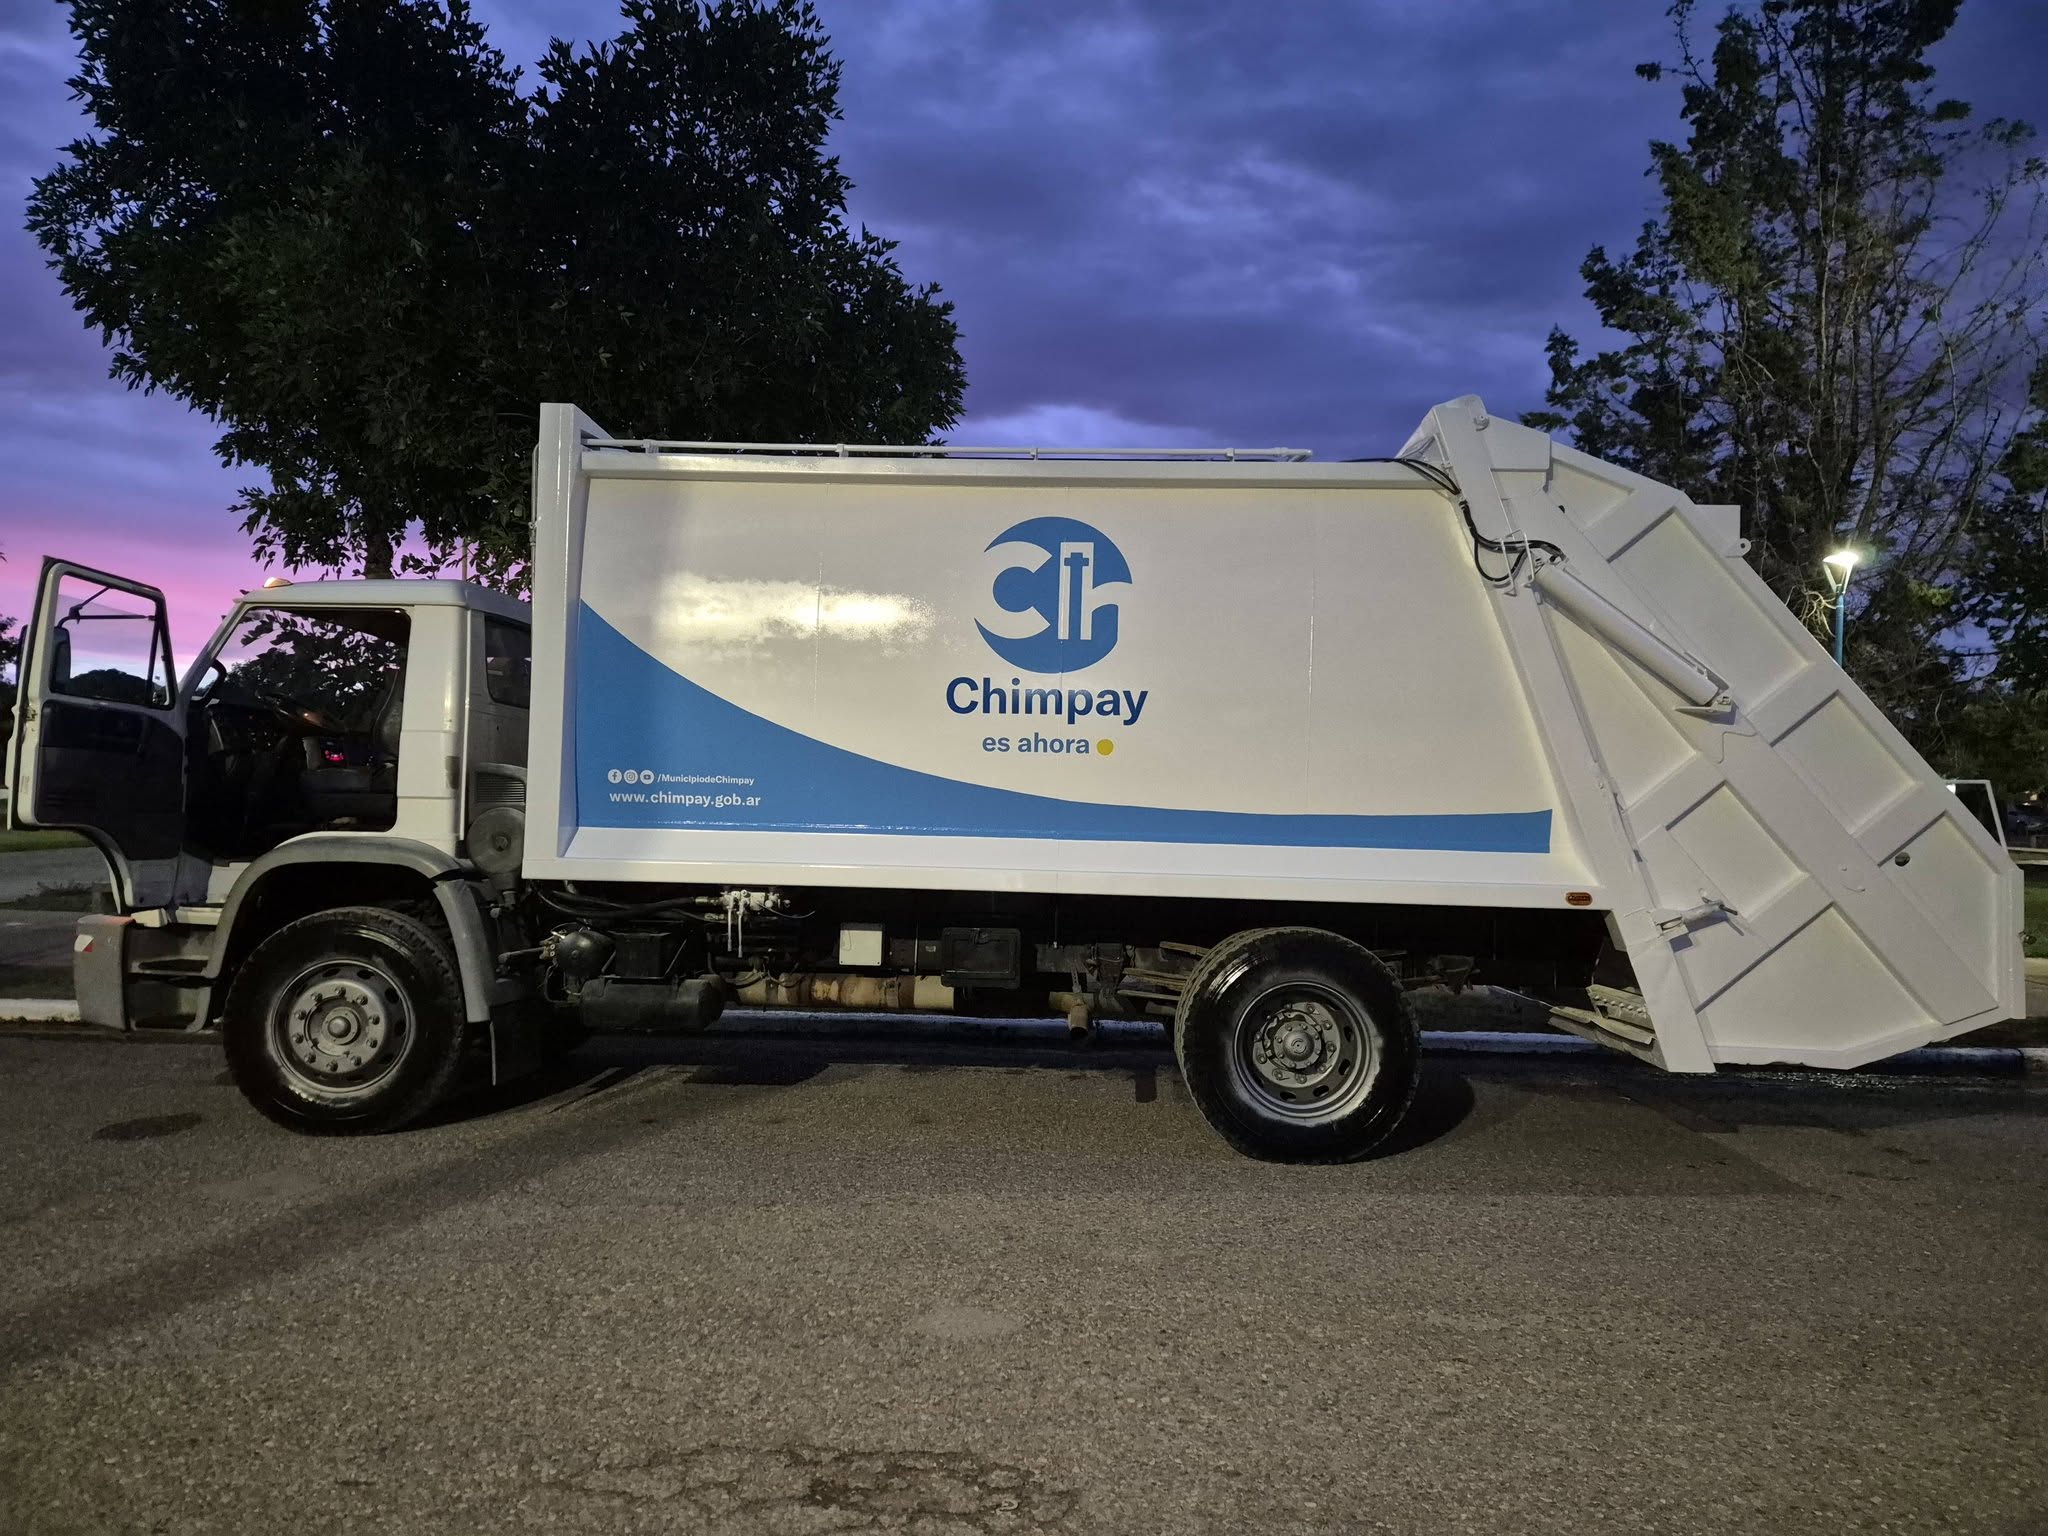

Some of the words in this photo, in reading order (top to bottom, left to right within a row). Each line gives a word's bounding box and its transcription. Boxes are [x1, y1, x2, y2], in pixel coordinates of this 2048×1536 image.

[945, 676, 1149, 727] Chimpay
[981, 736, 1011, 753] es
[1017, 732, 1090, 754] ahora
[609, 791, 761, 808] www.chimpay.gob.ar
